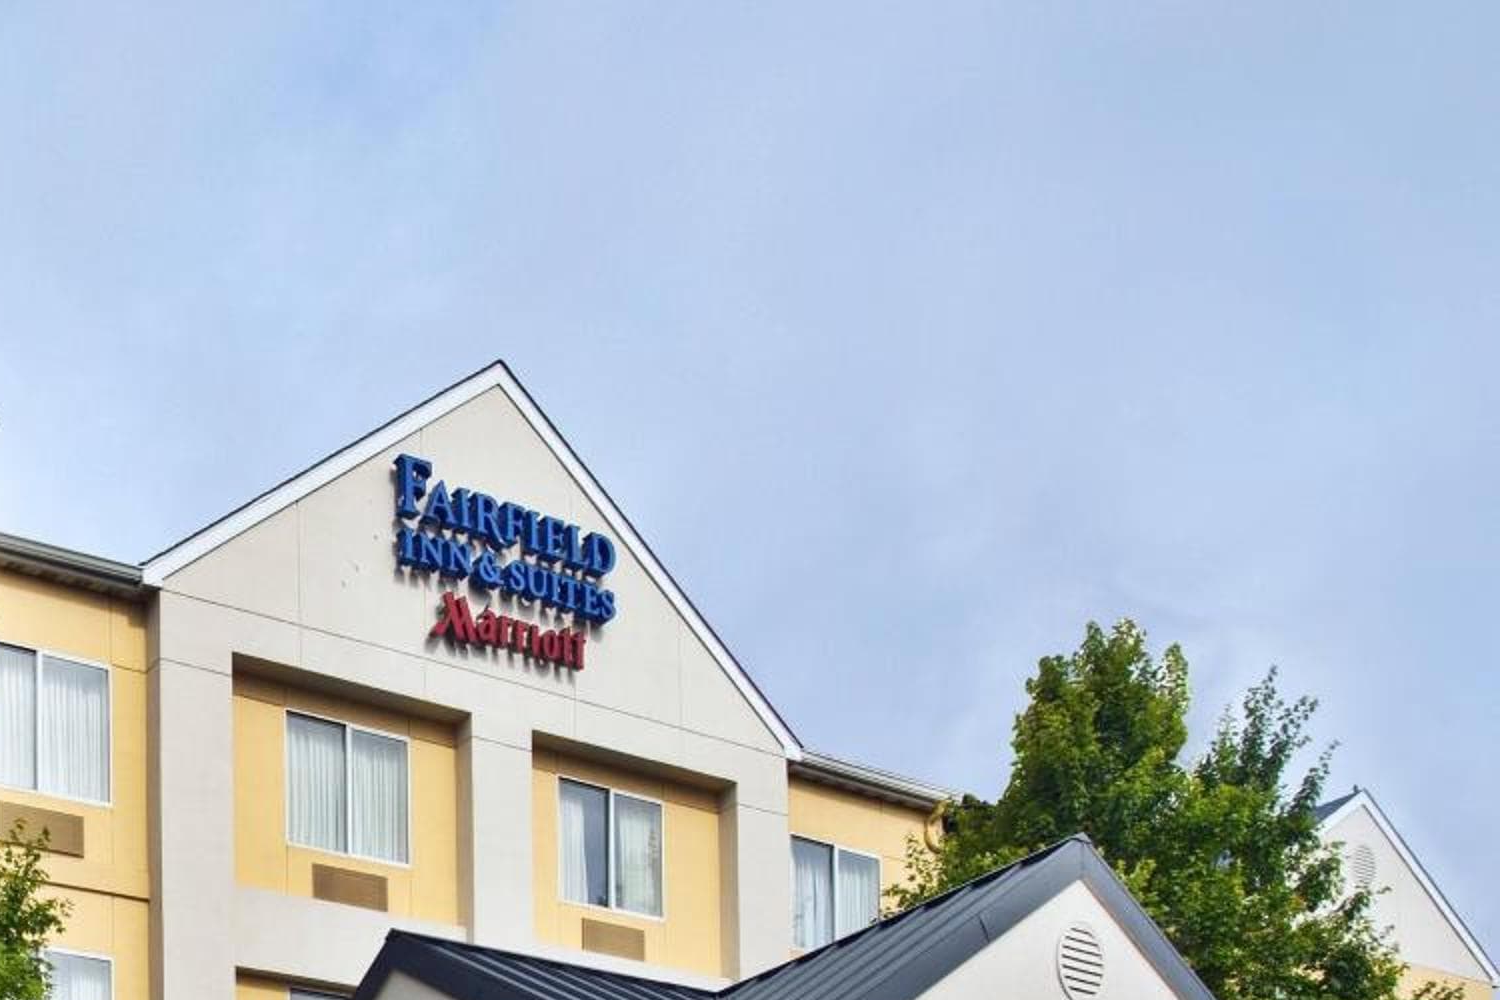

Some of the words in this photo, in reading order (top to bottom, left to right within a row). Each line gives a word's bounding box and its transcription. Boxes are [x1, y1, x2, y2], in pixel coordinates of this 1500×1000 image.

[393, 453, 616, 578] FAIRFIELD
[397, 528, 473, 580] INN
[473, 552, 503, 590] &
[503, 559, 616, 624] SUITES
[431, 591, 586, 671] Marriott
